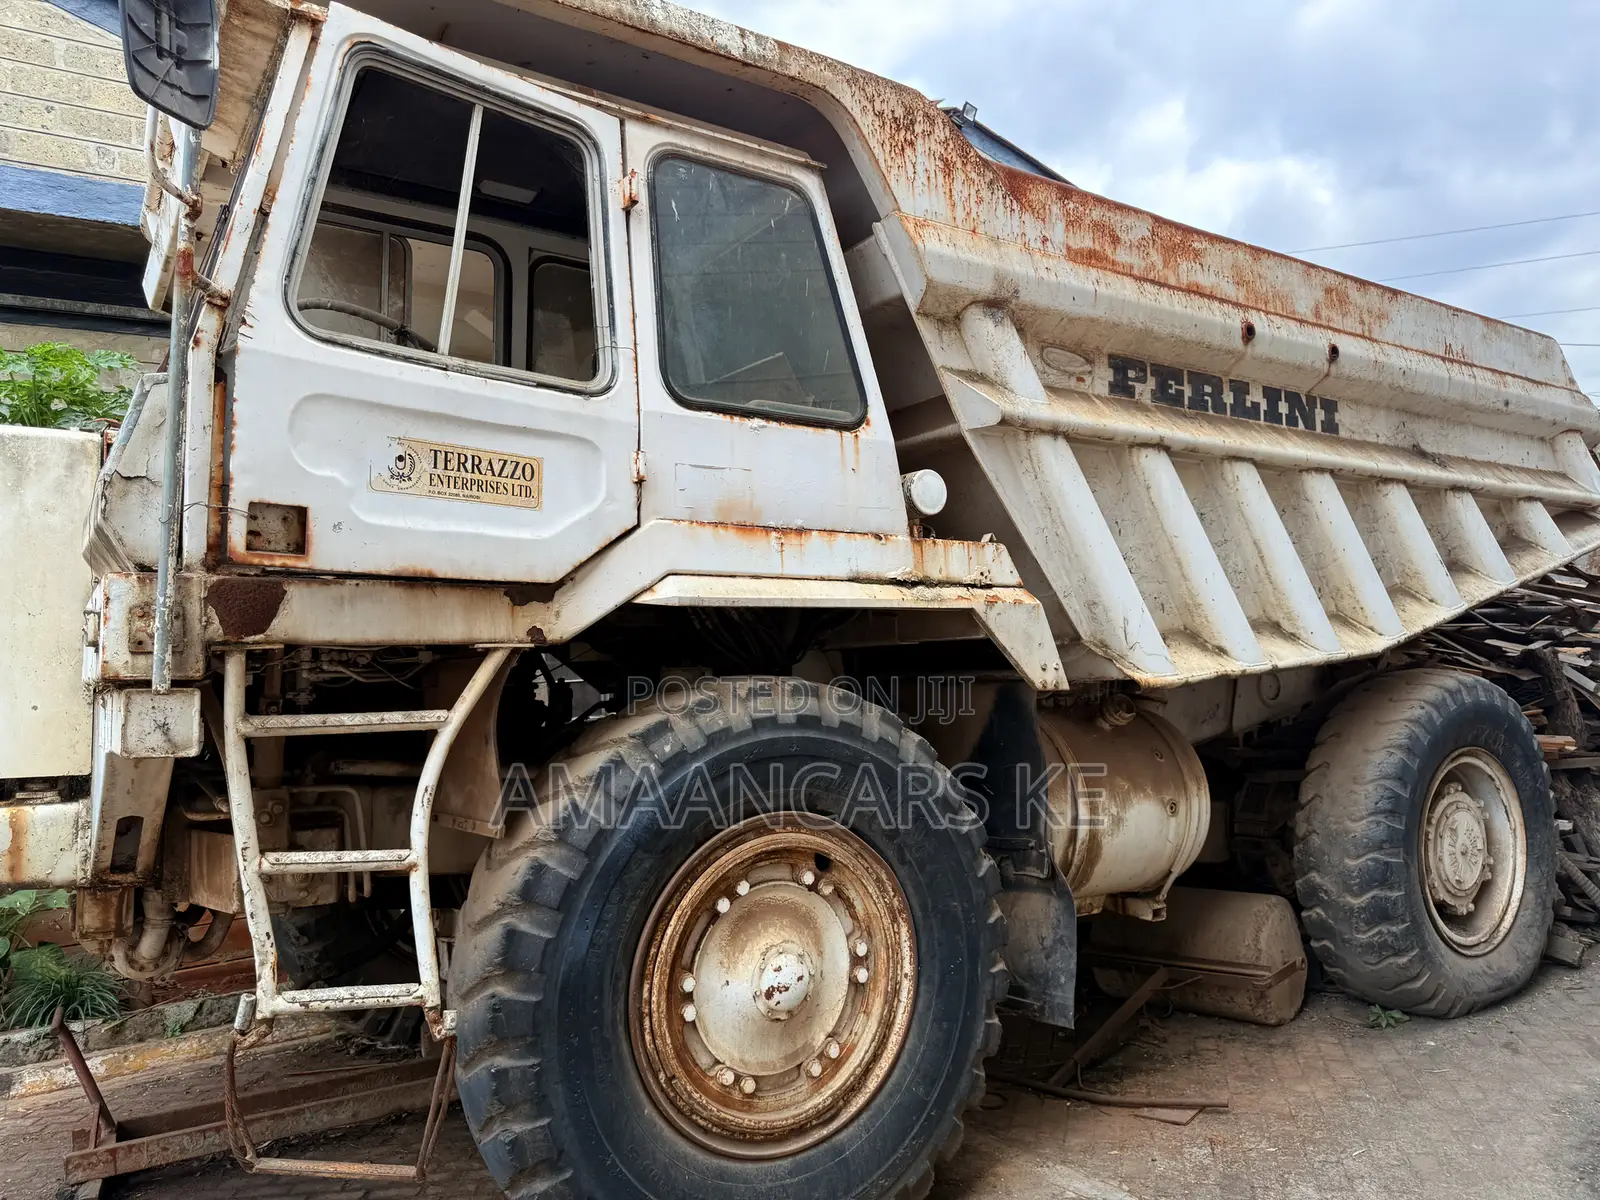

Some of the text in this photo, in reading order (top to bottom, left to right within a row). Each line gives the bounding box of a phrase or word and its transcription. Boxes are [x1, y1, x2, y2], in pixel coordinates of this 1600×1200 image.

[1108, 353, 1339, 436] PERLINI
[430, 449, 535, 482] TERRAZZO
[429, 473, 537, 499] ENTERPRISES LTD.
